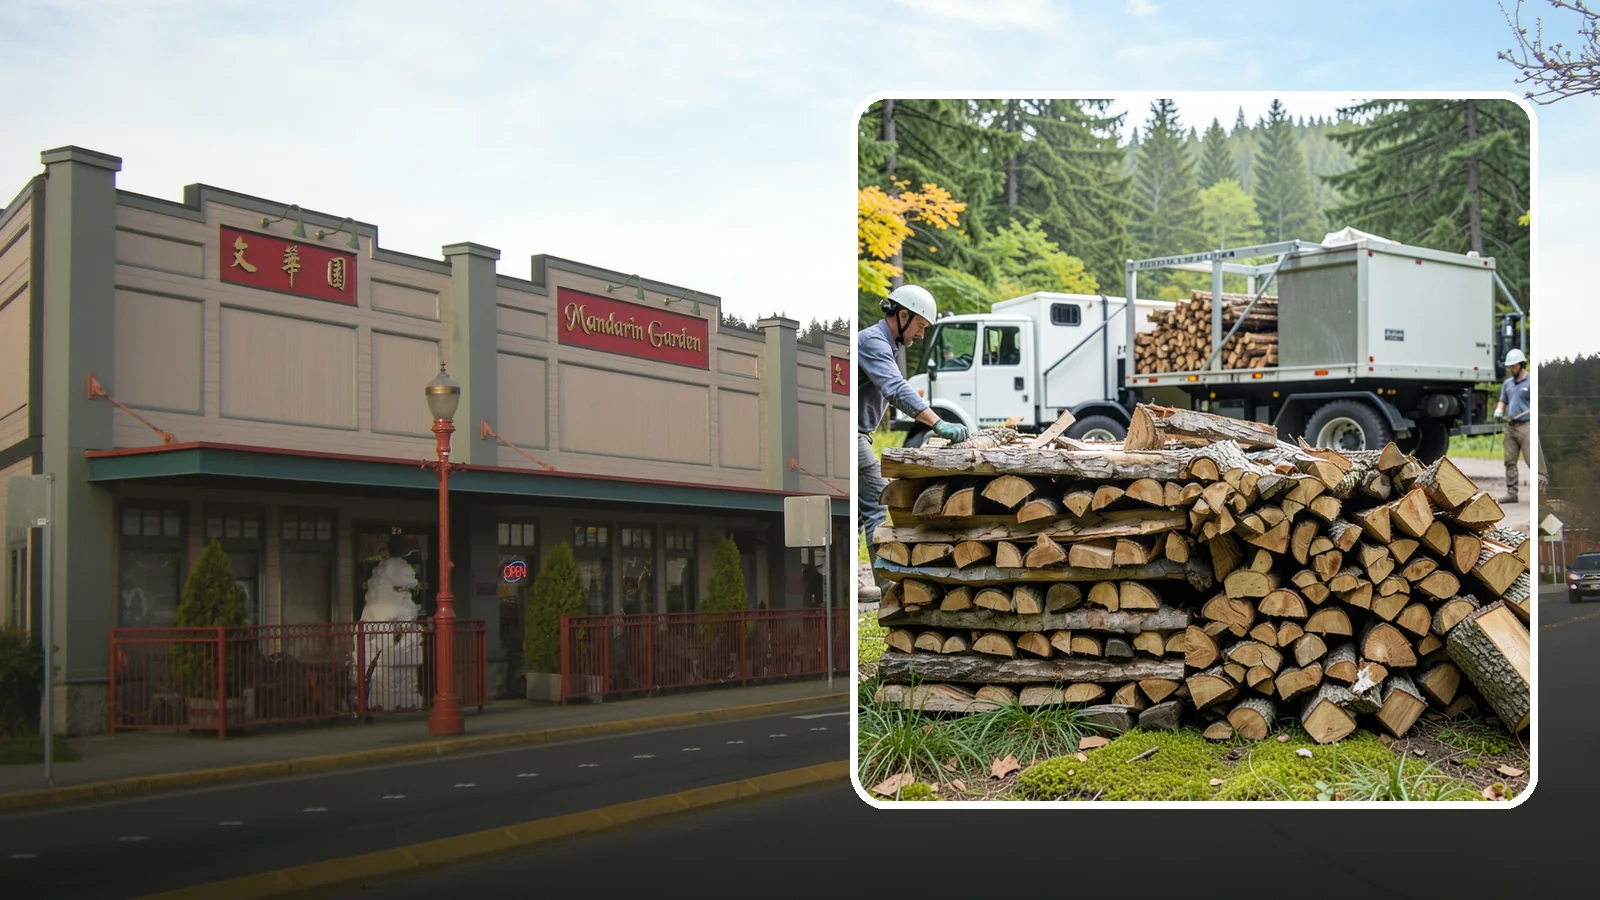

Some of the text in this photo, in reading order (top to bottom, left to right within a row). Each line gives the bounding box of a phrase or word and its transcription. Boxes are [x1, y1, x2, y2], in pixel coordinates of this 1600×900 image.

[231, 236, 346, 291] 文華園
[564, 302, 701, 352] Mandarin Garden
[504, 565, 527, 578] OPEN
